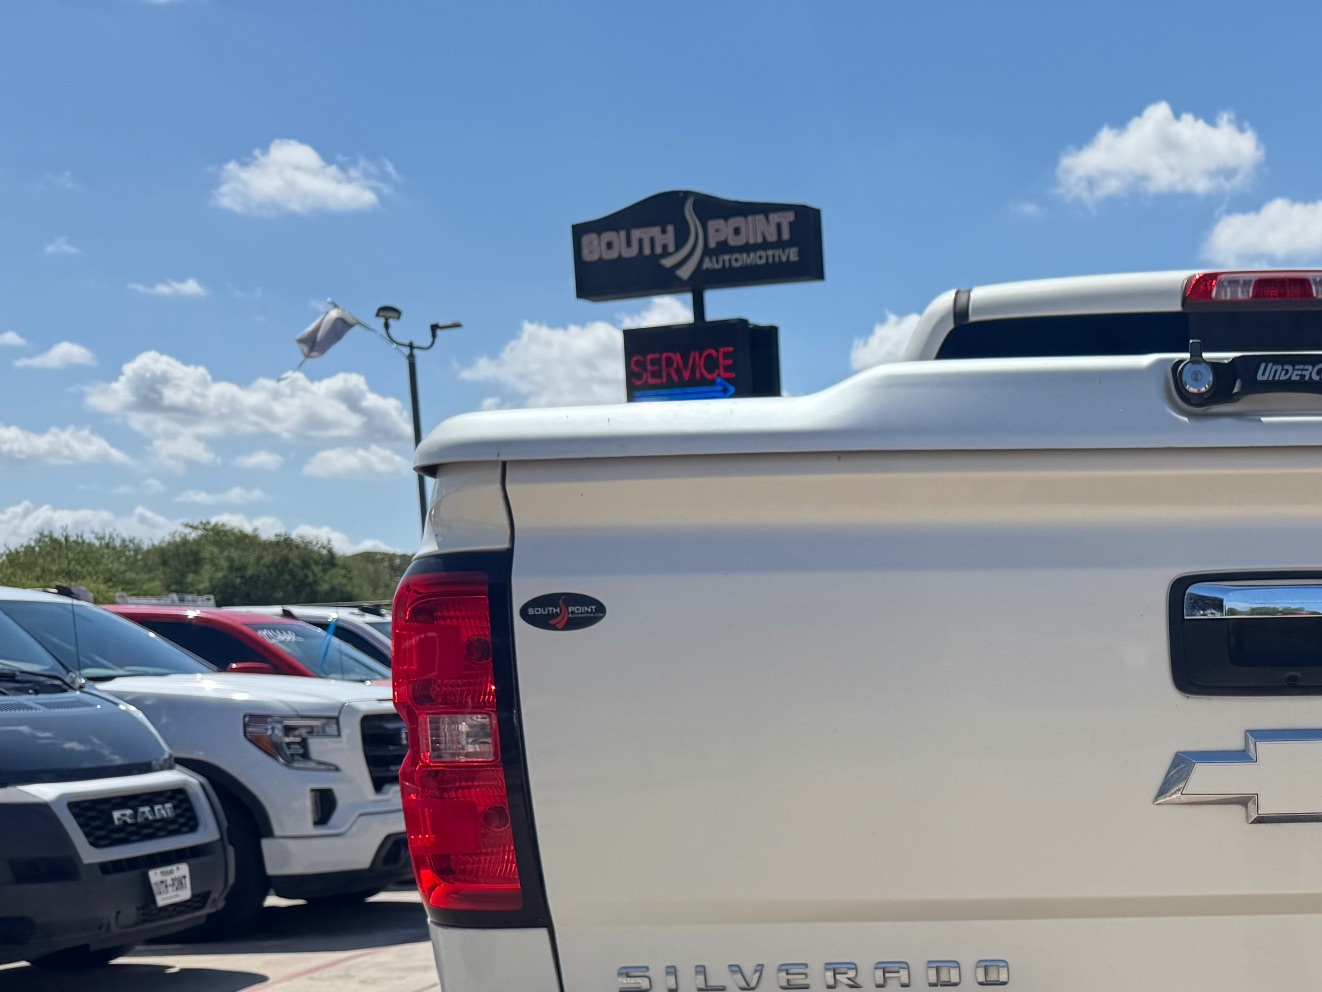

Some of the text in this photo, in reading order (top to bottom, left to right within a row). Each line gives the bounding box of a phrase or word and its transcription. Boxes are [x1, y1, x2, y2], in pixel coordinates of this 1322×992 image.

[580, 210, 796, 262] SOUTH POINT
[702, 247, 799, 270] AUTOMOTIVE
[630, 346, 736, 386] SERVICE
[528, 605, 597, 615] SOUTH POINT
[111, 802, 175, 826] RAM
[617, 958, 1010, 992] SILVERADO
